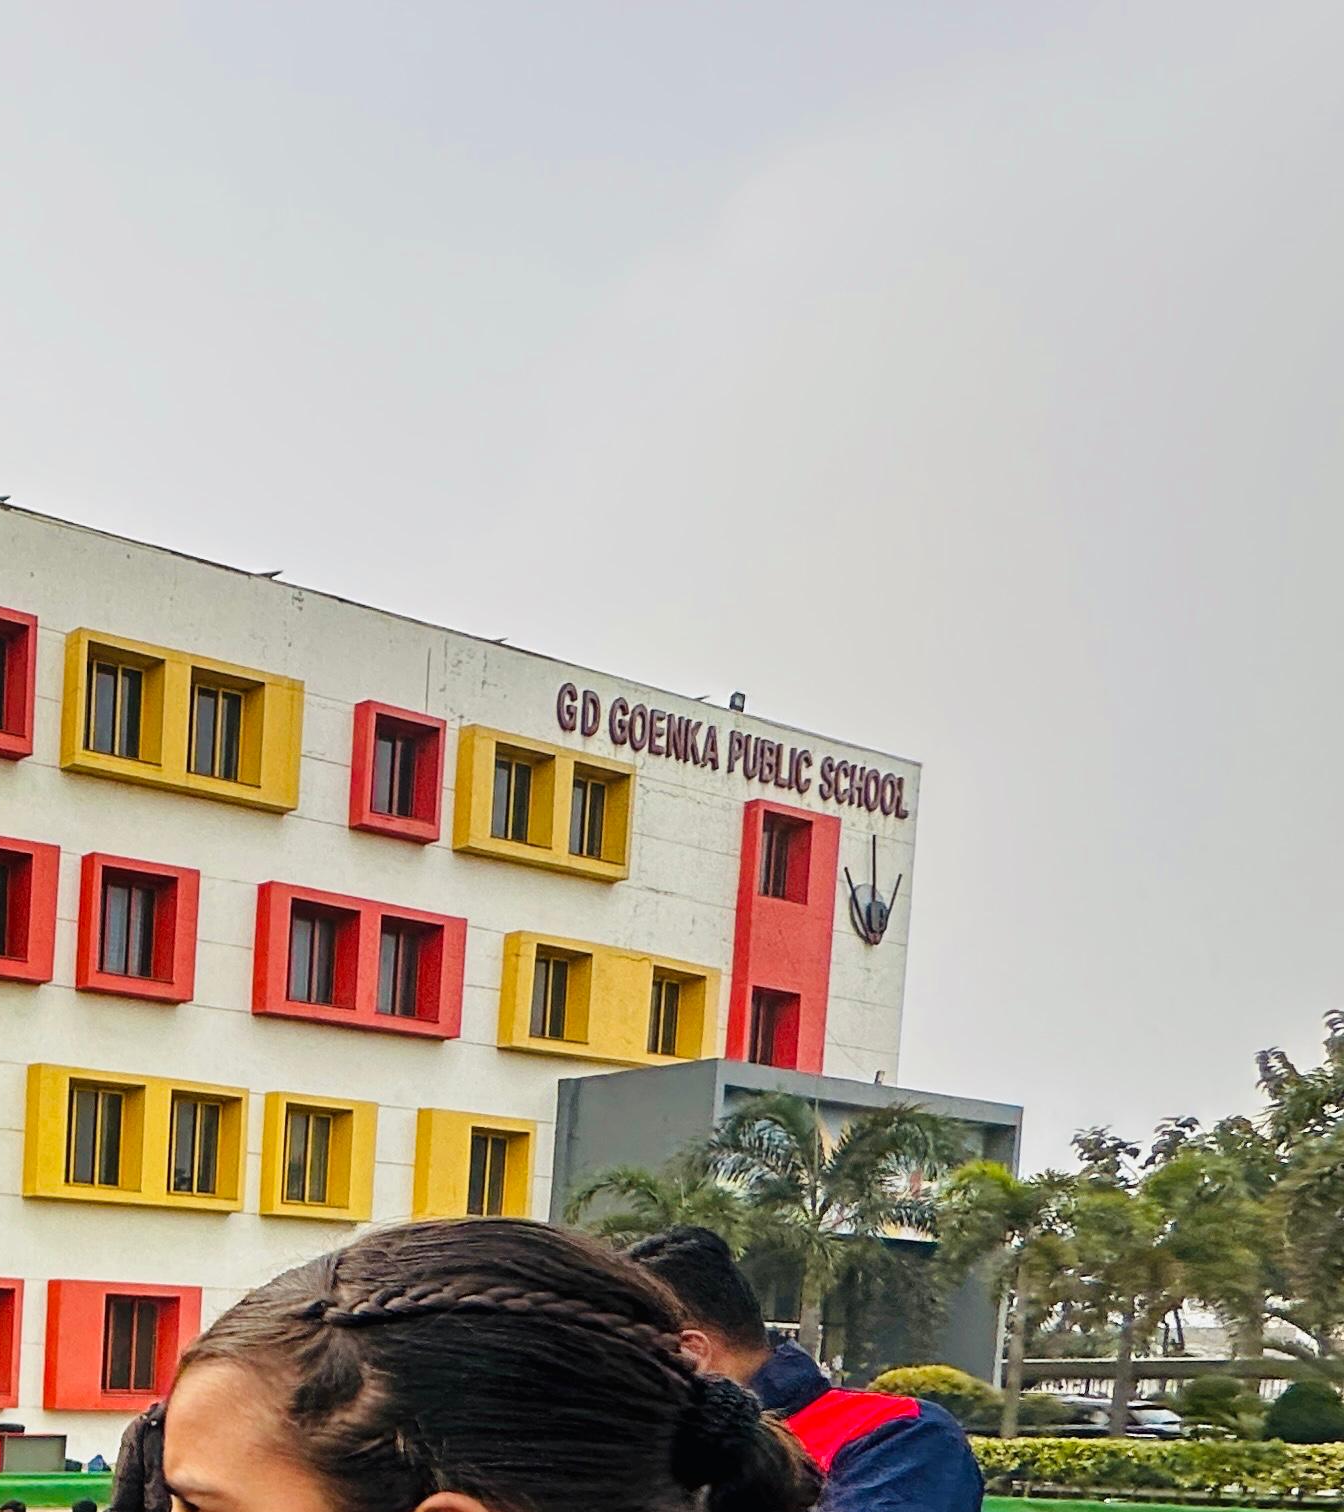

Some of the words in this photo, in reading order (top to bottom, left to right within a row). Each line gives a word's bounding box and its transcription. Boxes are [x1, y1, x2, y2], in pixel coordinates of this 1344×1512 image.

[609, 697, 719, 770] GOENKA
[727, 730, 812, 794] PUBLIC
[819, 756, 910, 819] SCHOOL
